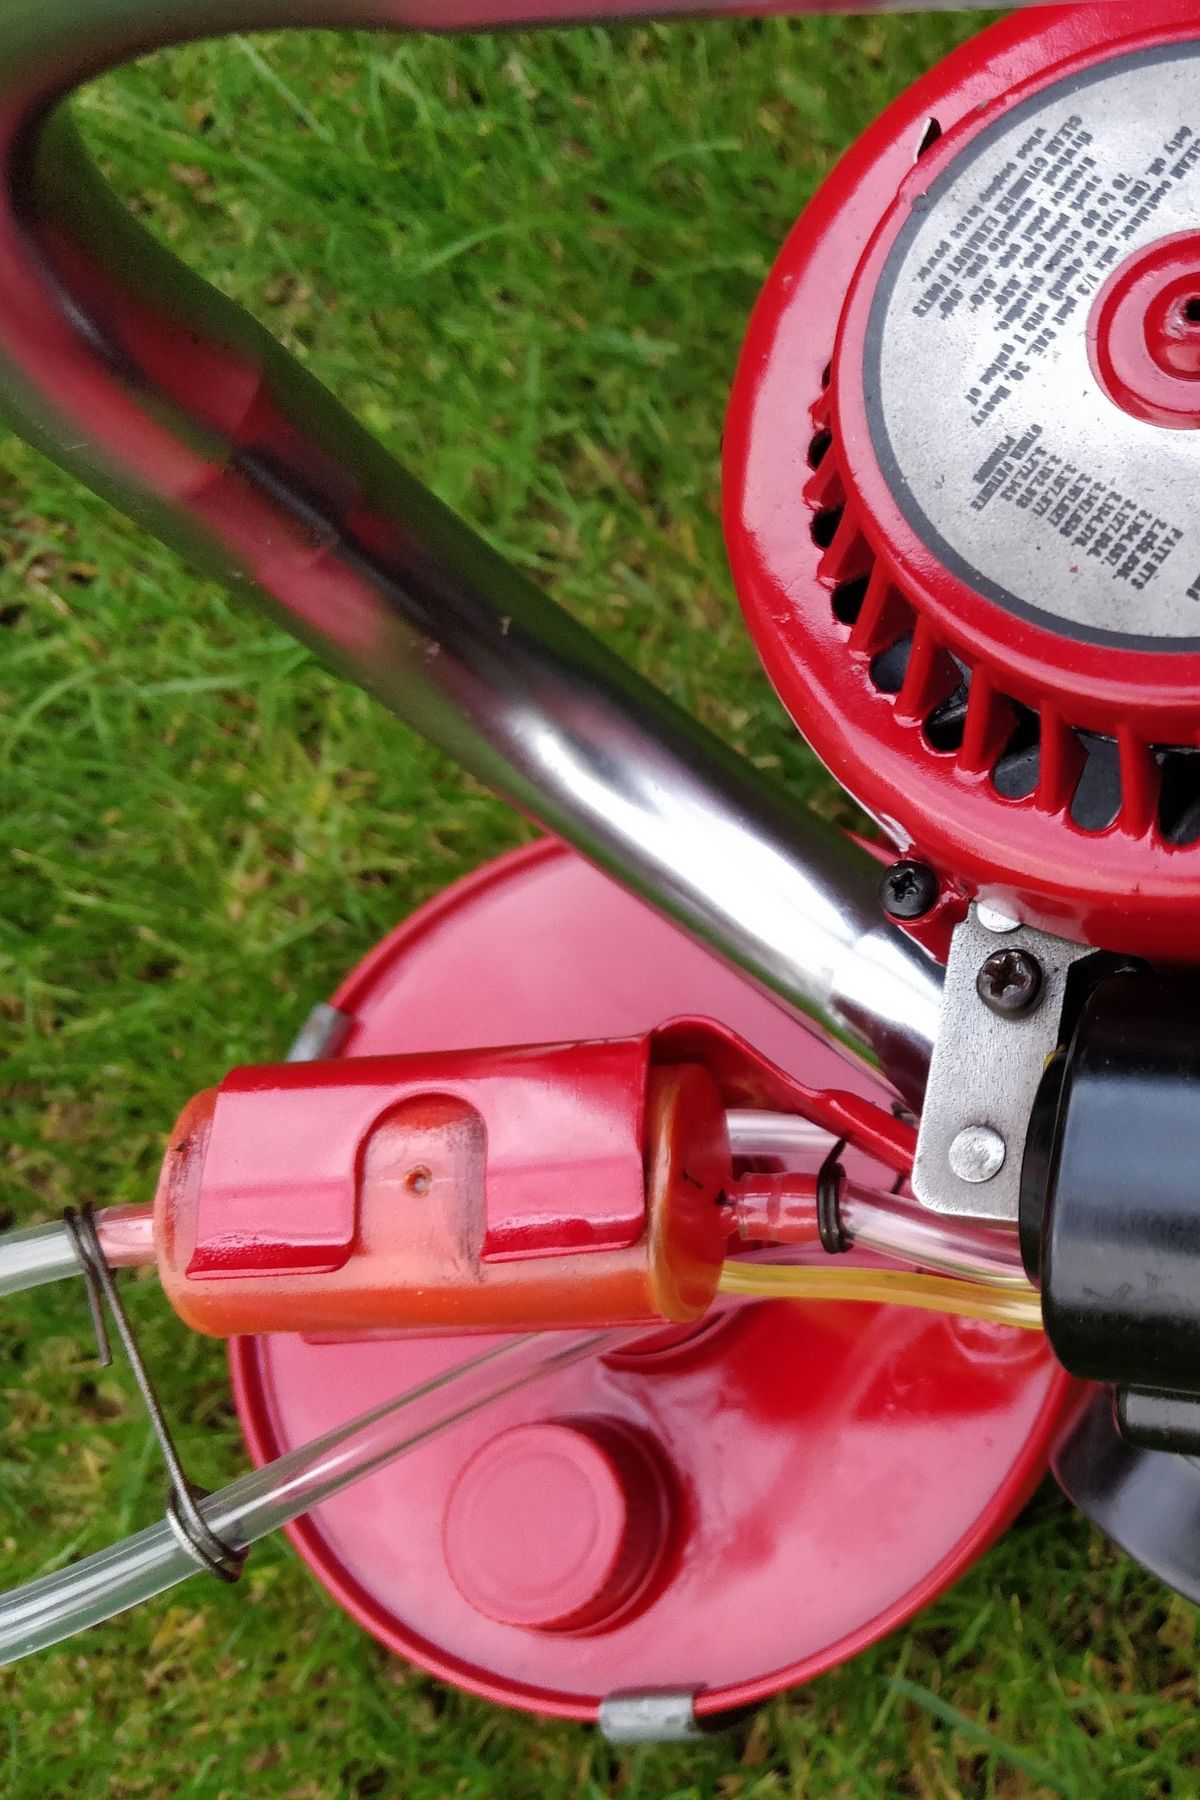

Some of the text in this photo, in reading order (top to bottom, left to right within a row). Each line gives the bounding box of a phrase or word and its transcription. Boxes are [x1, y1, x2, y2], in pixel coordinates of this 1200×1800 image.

[1162, 123, 1193, 156] duty
[1048, 154, 1097, 208] Breaker
[1096, 190, 1117, 208] to
[910, 125, 1048, 284] when engine loses power.
[910, 112, 1083, 318] CLEAN CYLINDER EXHAUST PORTS
[986, 195, 1037, 254] magneto
[1018, 205, 1052, 244] point
[1042, 211, 1072, 244] plug
[1094, 206, 1128, 240] type
[1041, 228, 1084, 276] octane
[1080, 238, 1100, 257] or
[1092, 244, 1120, 272] mix
[1020, 300, 1050, 334] with
[1050, 294, 1080, 326] pint
[1012, 332, 1026, 345] 1
[978, 341, 1017, 387] gallon
[964, 386, 984, 406] of
[969, 382, 1011, 428] Heavy
[968, 421, 1044, 512] OTHER PATENTS
[1129, 526, 1184, 591] PATENTS
